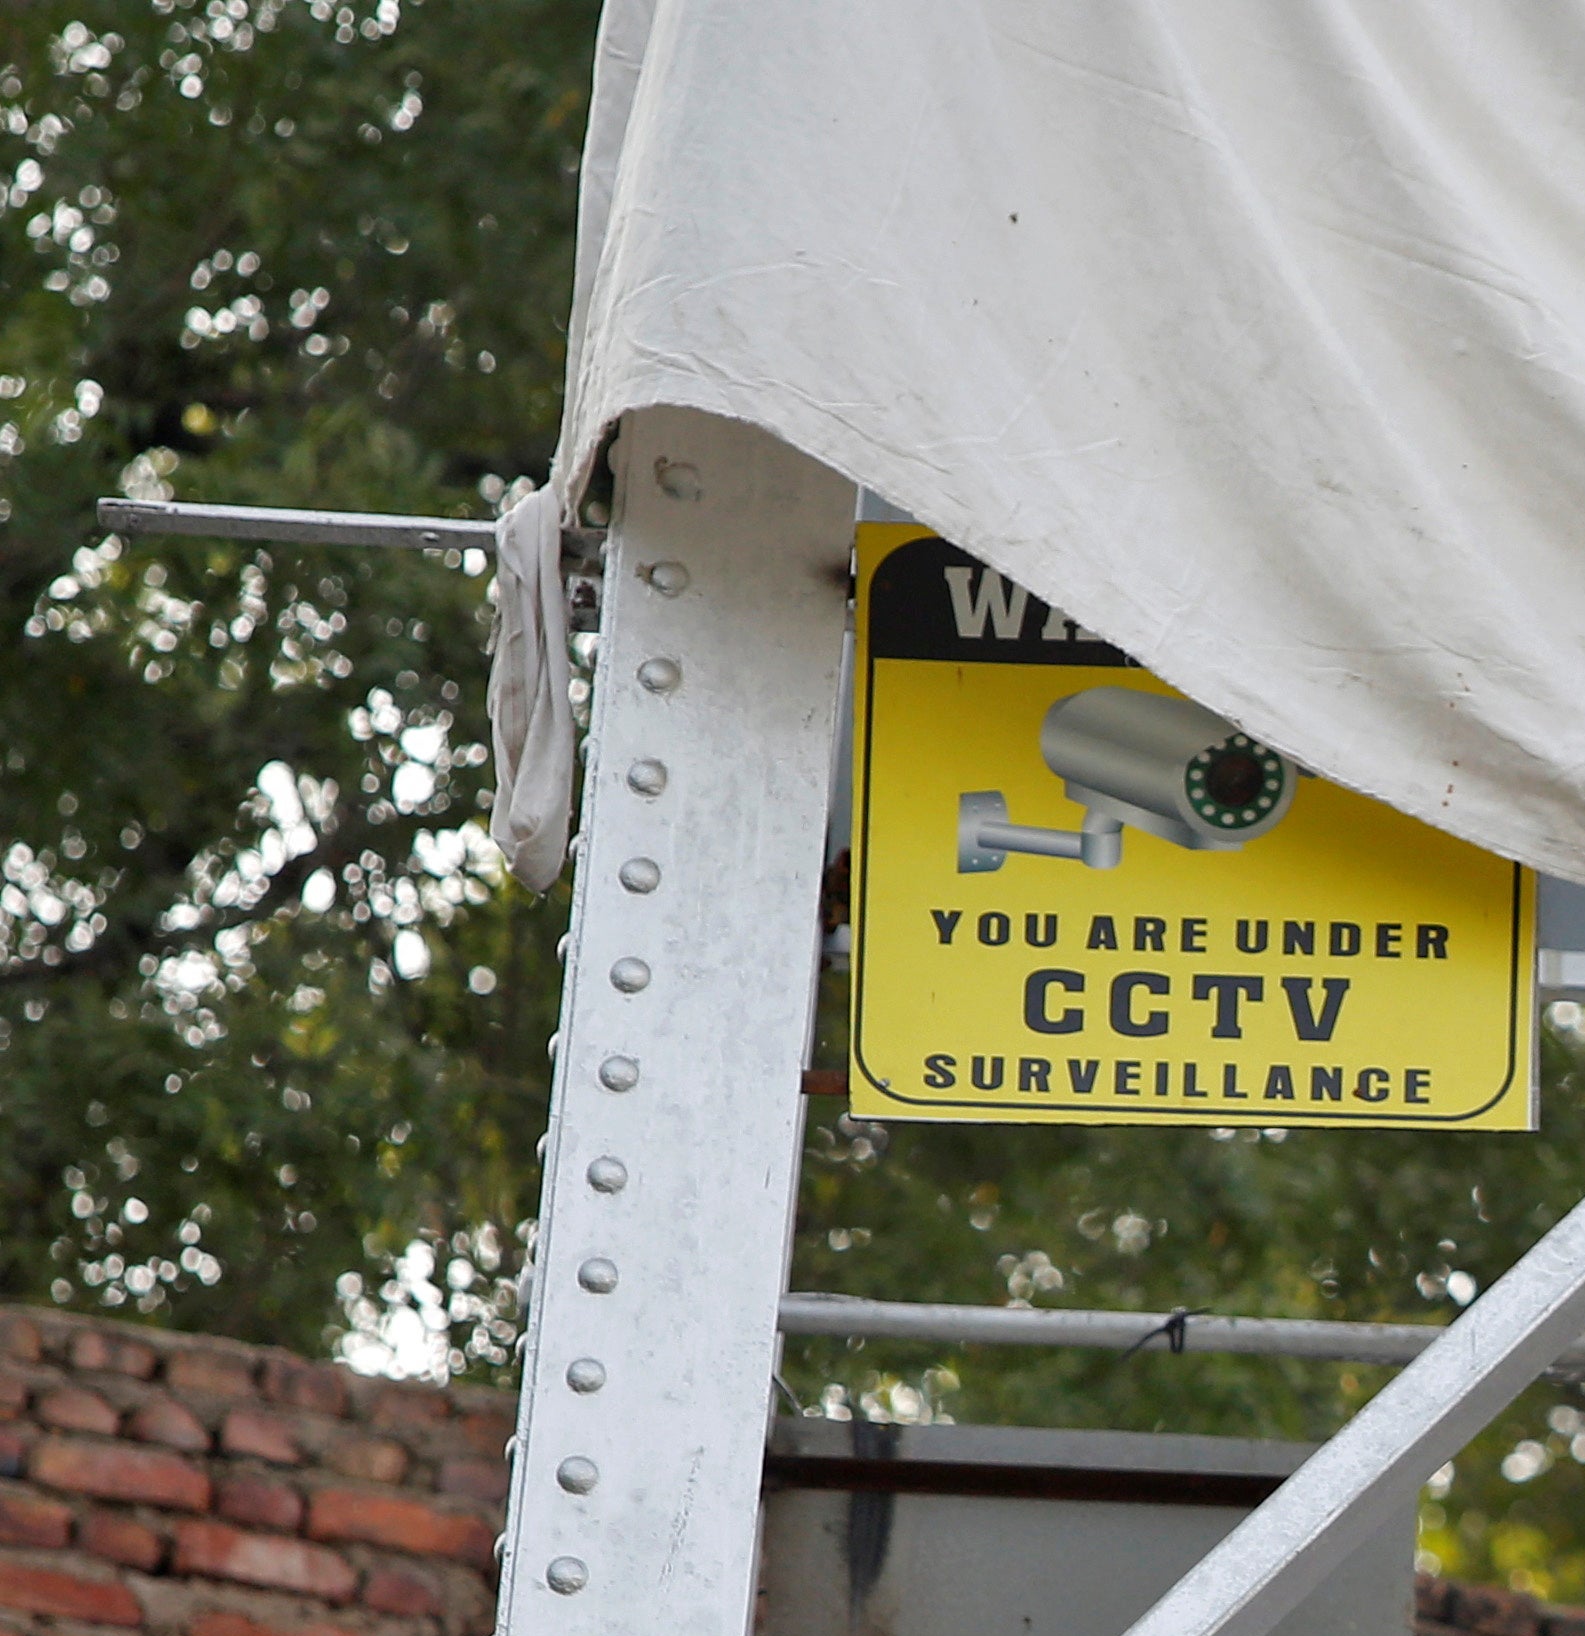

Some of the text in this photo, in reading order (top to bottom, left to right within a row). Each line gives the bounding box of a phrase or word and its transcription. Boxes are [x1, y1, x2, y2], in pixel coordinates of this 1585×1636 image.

[930, 909, 1449, 959] YOU ARE UNDER
[1023, 968, 1351, 1042] CCTV
[923, 1053, 1432, 1104] SURVEILLANCE
